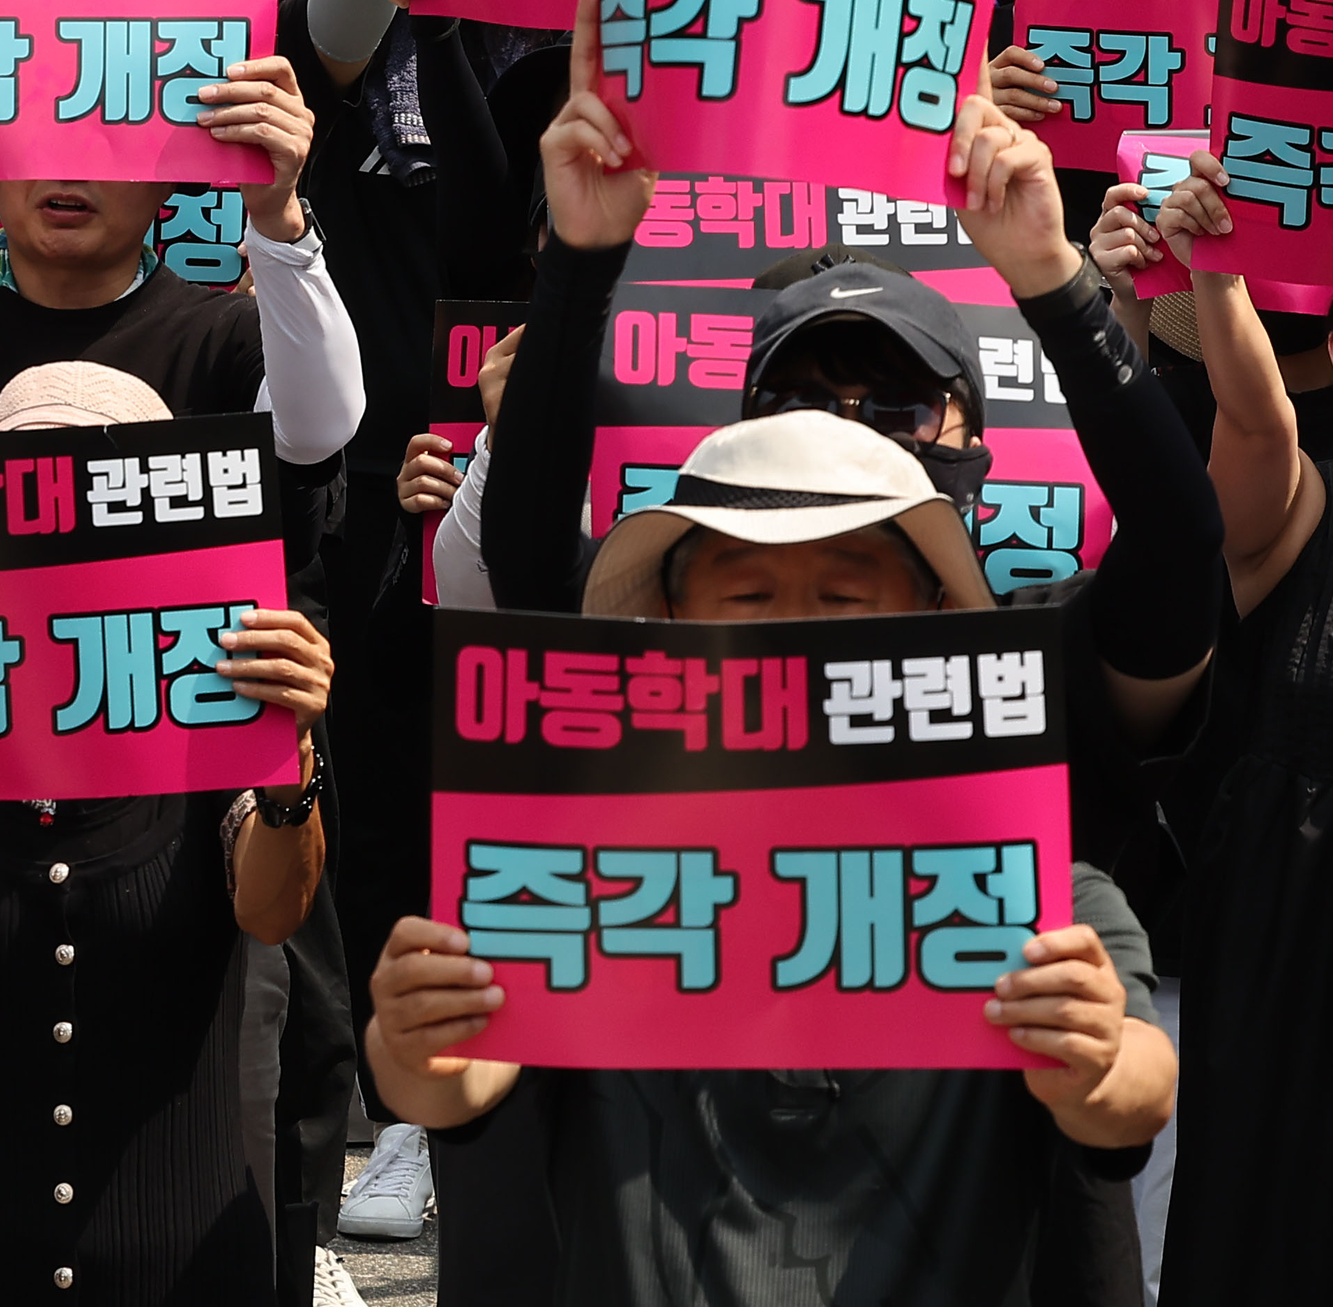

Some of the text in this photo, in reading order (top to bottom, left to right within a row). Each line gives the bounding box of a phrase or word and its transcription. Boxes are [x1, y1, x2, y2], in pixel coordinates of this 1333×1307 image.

[55, 18, 251, 124] 개정
[1023, 25, 1186, 127] 즉각
[86, 448, 264, 528] 관련법
[49, 601, 263, 733] 개정
[455, 645, 1047, 752] 아동학대 관련법
[460, 839, 1041, 993] 즉각 개정
